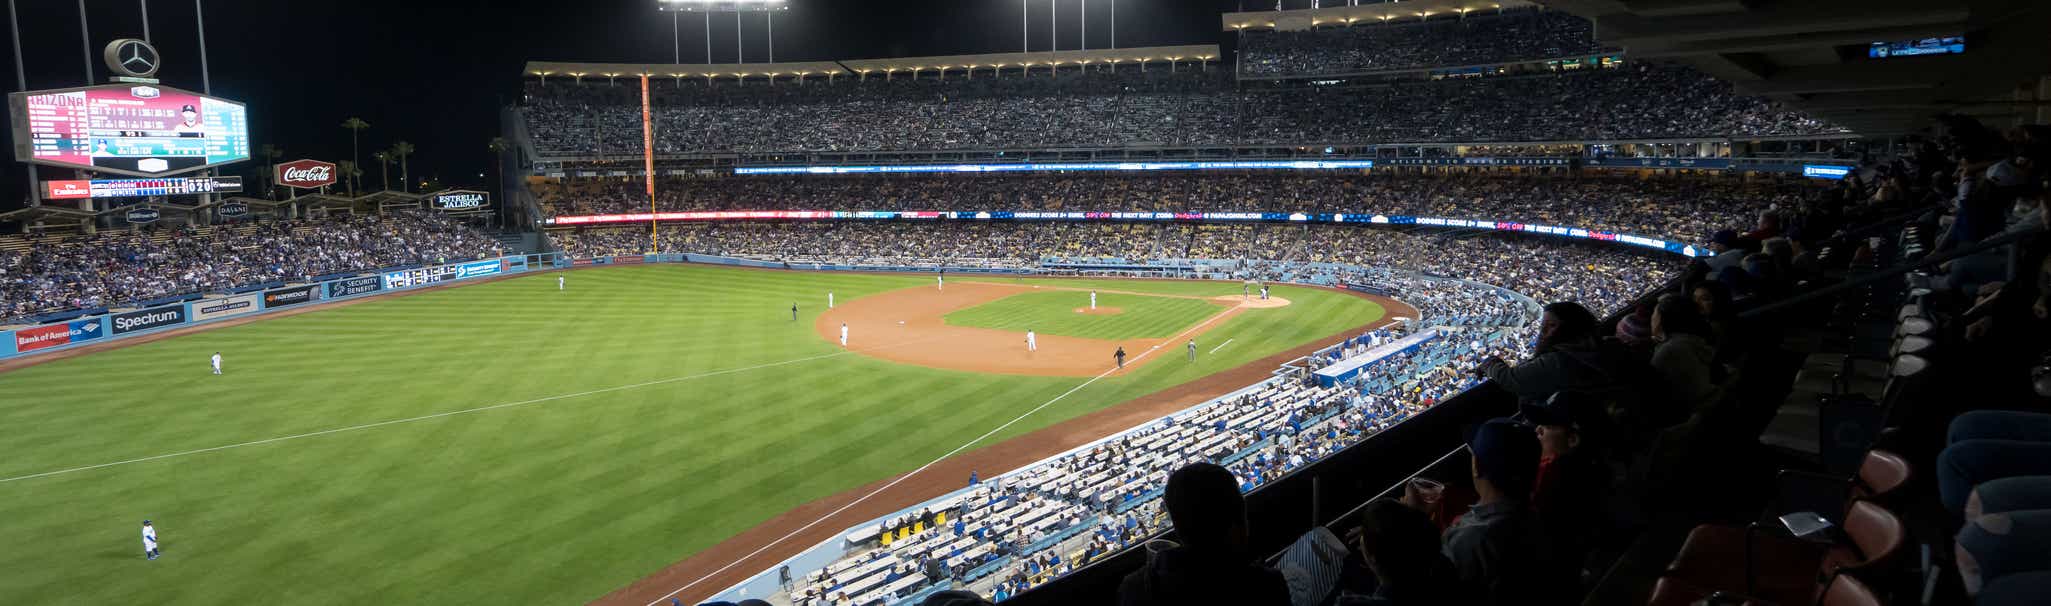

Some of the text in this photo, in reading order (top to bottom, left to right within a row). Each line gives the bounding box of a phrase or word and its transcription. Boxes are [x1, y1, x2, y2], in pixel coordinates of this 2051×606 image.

[53, 188, 89, 196] Emirates
[439, 194, 483, 203] ESTRELLA
[444, 200, 479, 209] JALISCO
[1416, 218, 1446, 226] DODGERS
[346, 276, 377, 288] SECURITY
[115, 310, 178, 331] Spectrum
[18, 329, 82, 345] Bank of America
